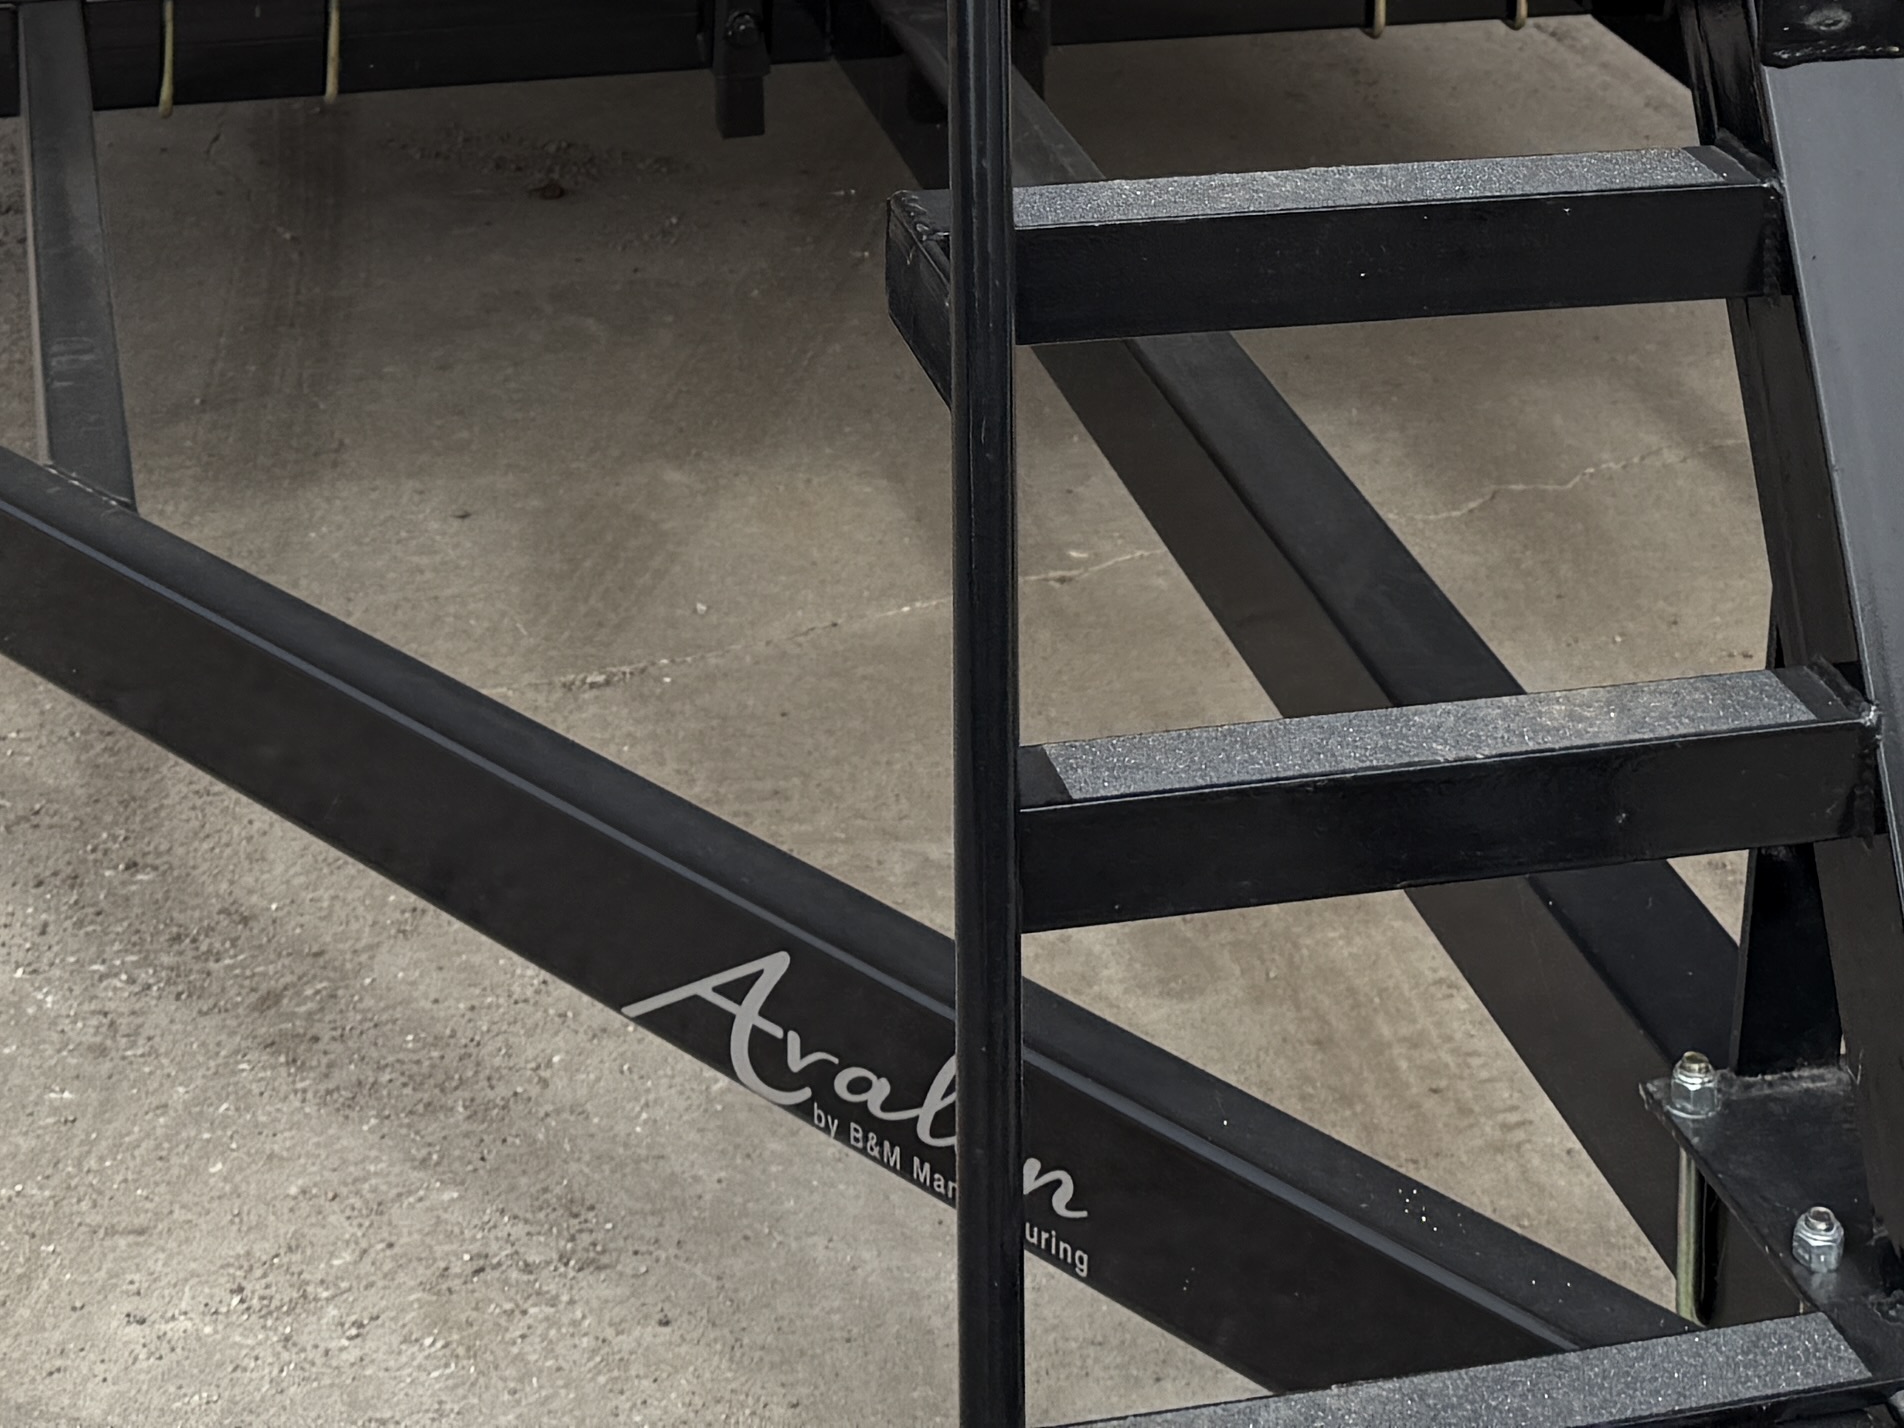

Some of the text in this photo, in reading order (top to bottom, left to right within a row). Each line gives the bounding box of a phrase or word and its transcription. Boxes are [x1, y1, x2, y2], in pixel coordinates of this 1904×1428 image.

[620, 950, 1089, 1218] Avaln
[813, 1101, 839, 1140] by
[849, 1121, 901, 1171] B&M
